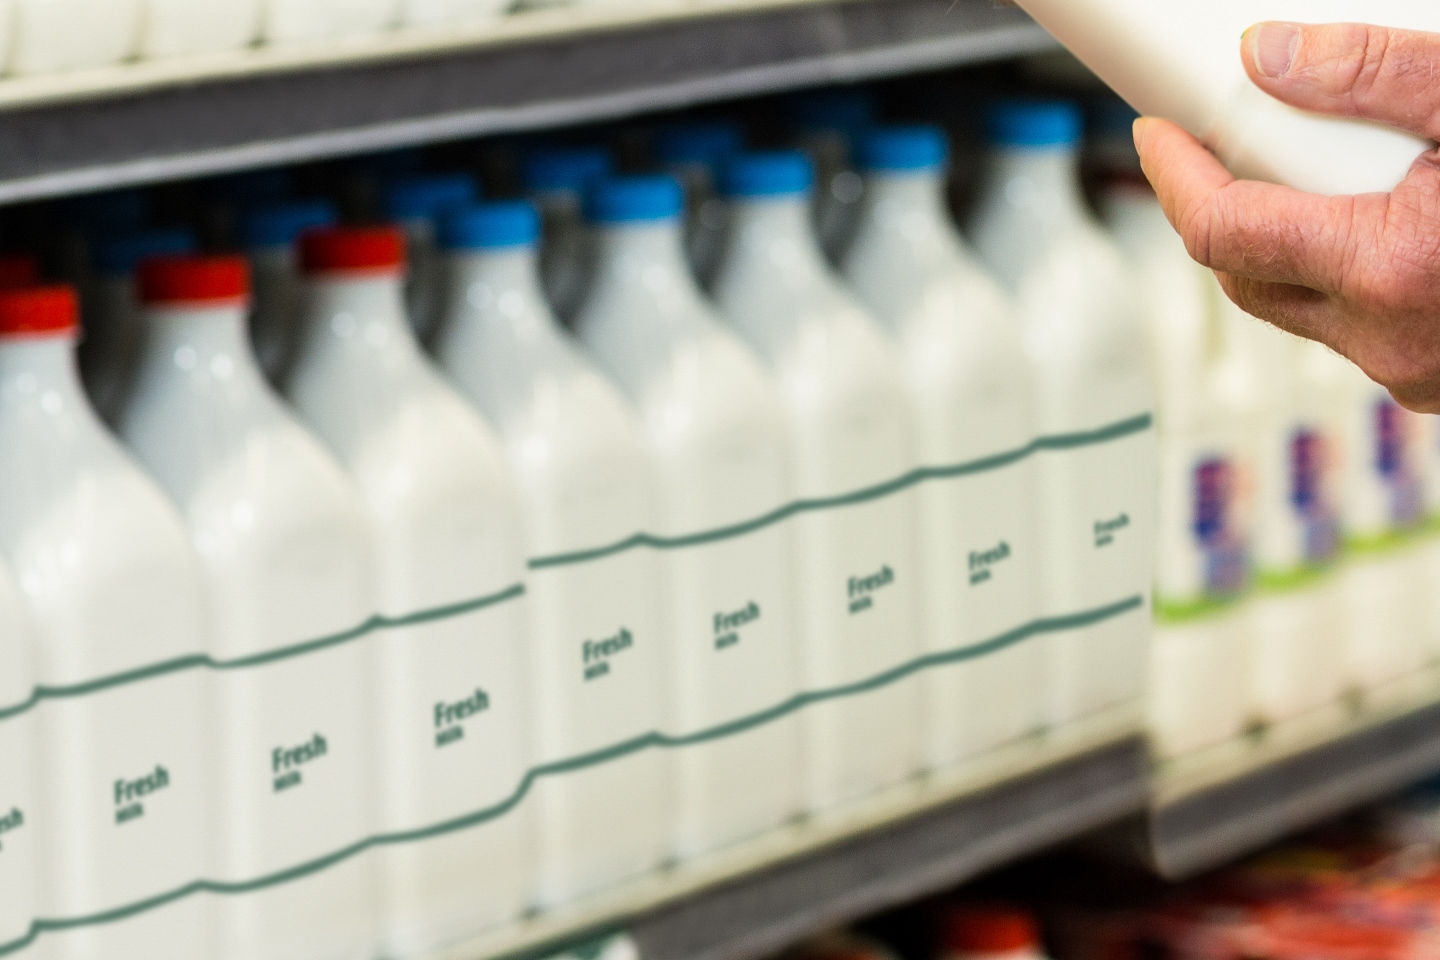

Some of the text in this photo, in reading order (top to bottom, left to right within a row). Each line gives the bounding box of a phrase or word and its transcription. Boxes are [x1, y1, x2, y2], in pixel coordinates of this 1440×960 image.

[968, 540, 1012, 573] Fresh
[848, 564, 895, 599] Fresh
[713, 600, 761, 635] Fresh
[582, 627, 634, 665] Fresh
[434, 688, 490, 729] Fresh
[272, 733, 328, 774] Fresh
[114, 765, 170, 806] Fresh
